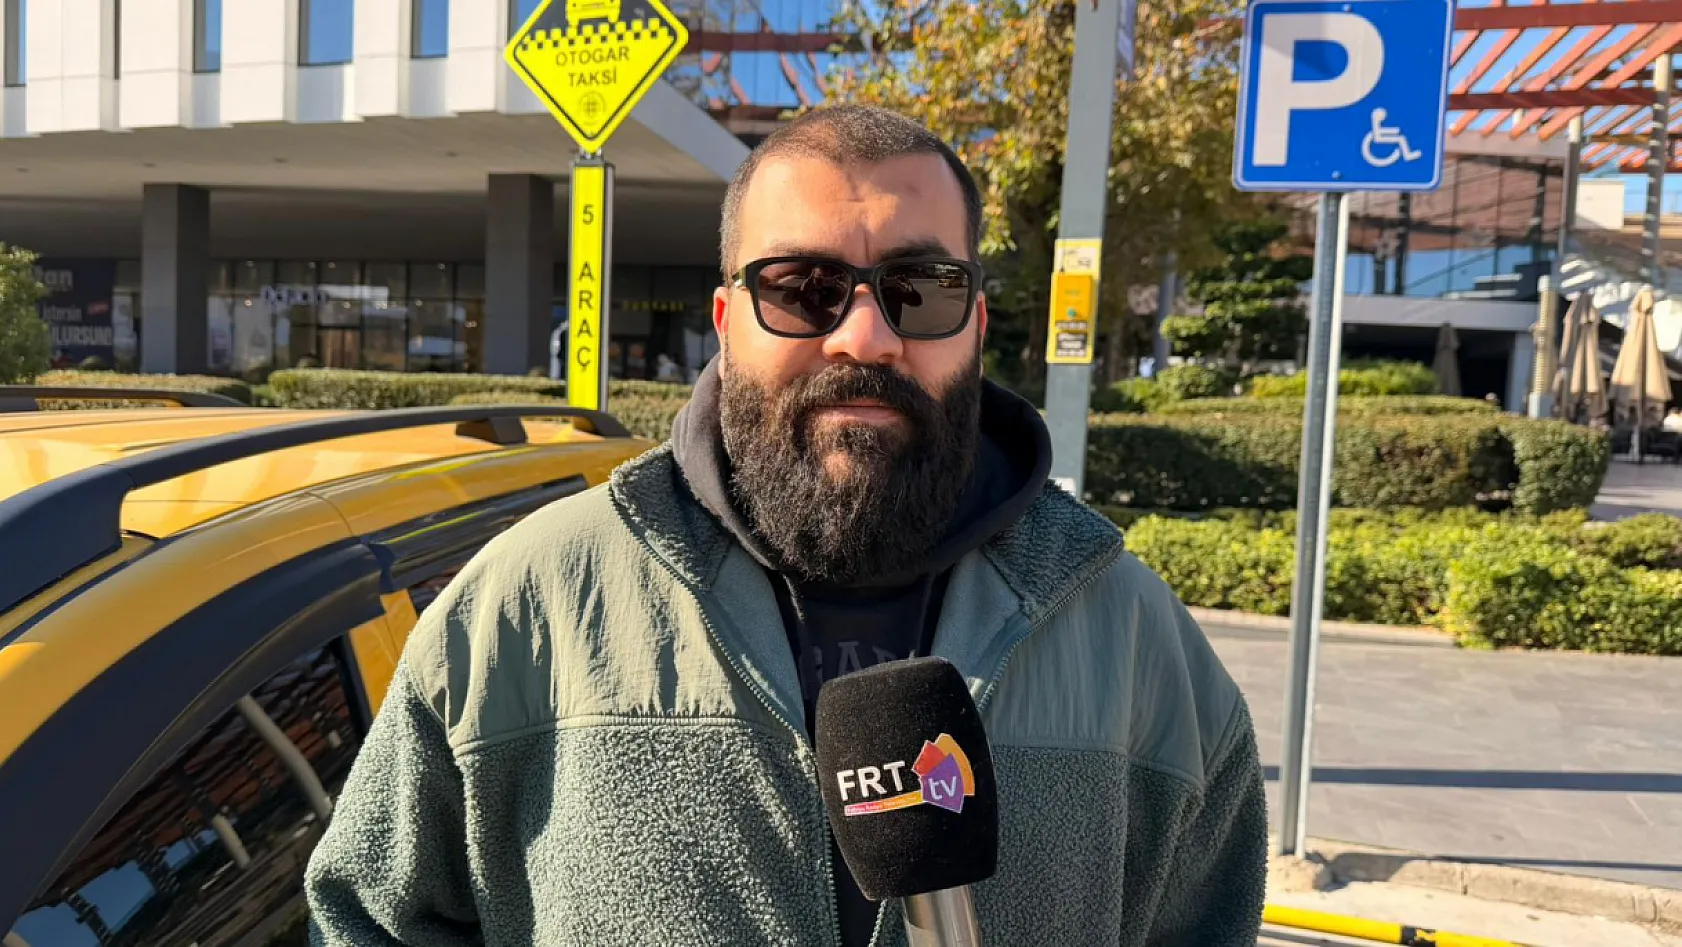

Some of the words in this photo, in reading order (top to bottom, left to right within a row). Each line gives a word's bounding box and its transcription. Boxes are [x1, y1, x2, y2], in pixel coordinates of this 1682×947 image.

[555, 46, 630, 67] OTOGAR
[567, 67, 617, 87] TAKSİ
[1252, 12, 1385, 166] P
[582, 204, 595, 225] 5
[576, 261, 595, 373] ARAÇ
[836, 760, 906, 801] FRT
[928, 776, 957, 800] tv
